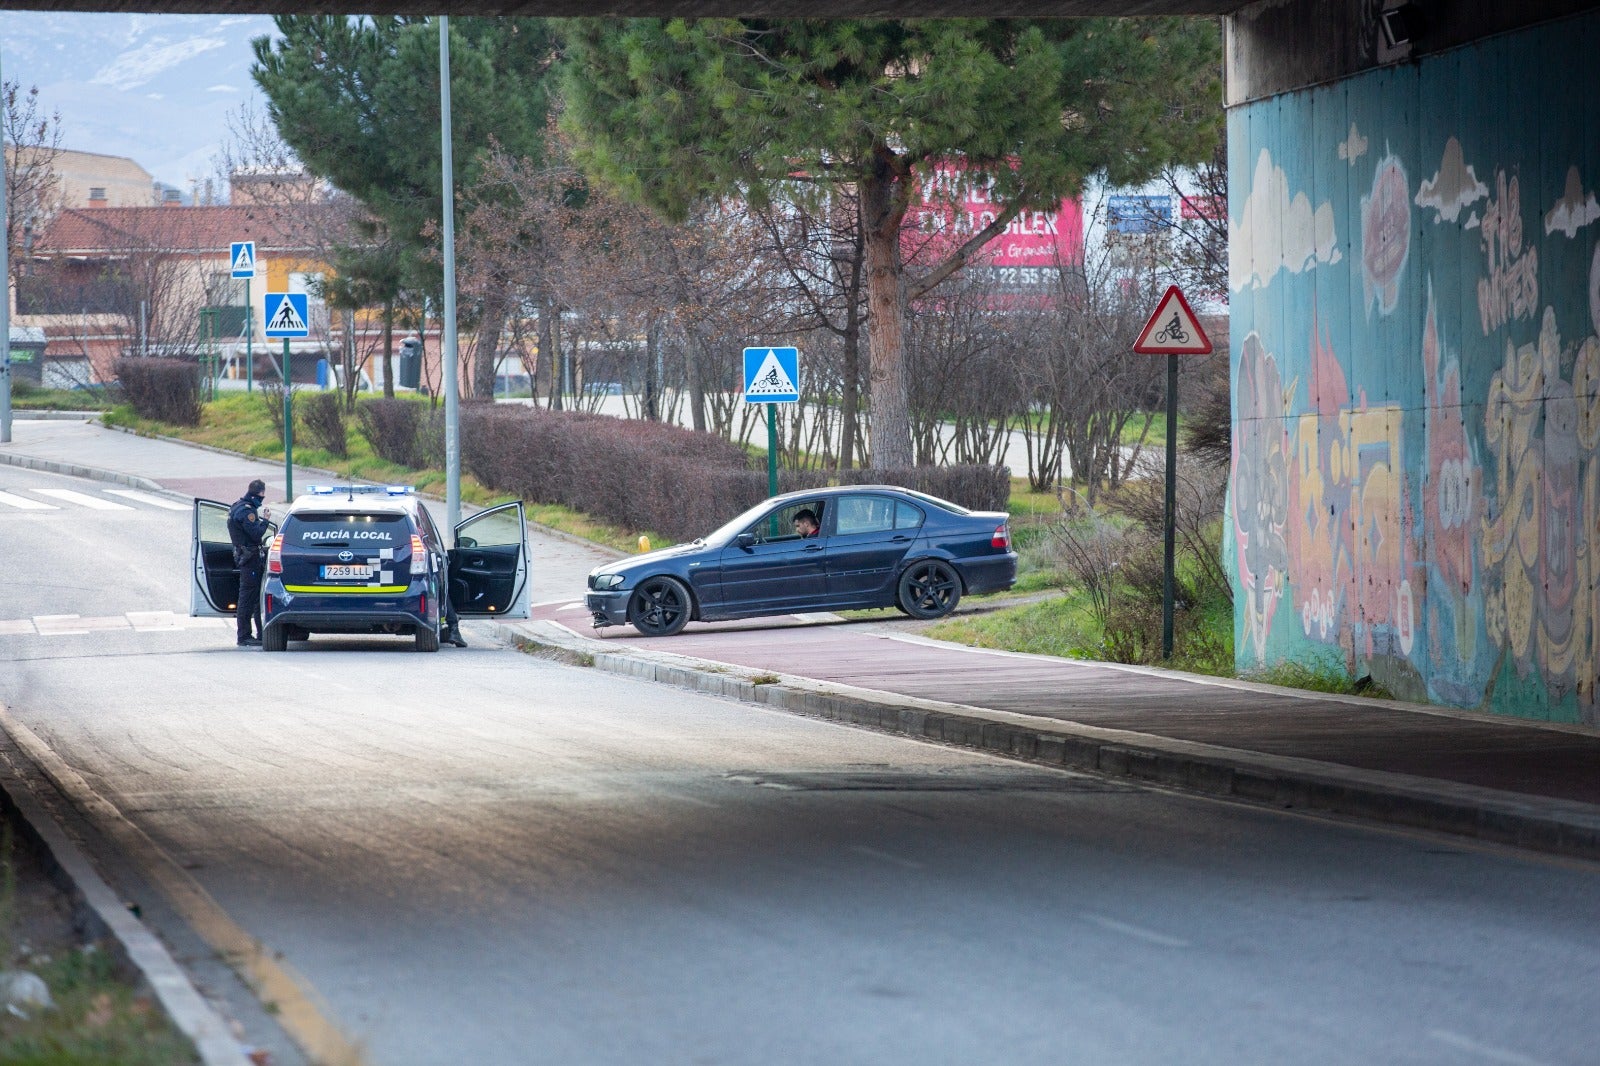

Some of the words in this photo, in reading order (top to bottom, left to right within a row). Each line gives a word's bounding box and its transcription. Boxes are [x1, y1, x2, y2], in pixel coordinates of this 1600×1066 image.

[302, 529, 350, 540] POLICÍA
[353, 531, 393, 540] LOCAL
[326, 566, 351, 576] 7259
[353, 566, 371, 576] LLL
